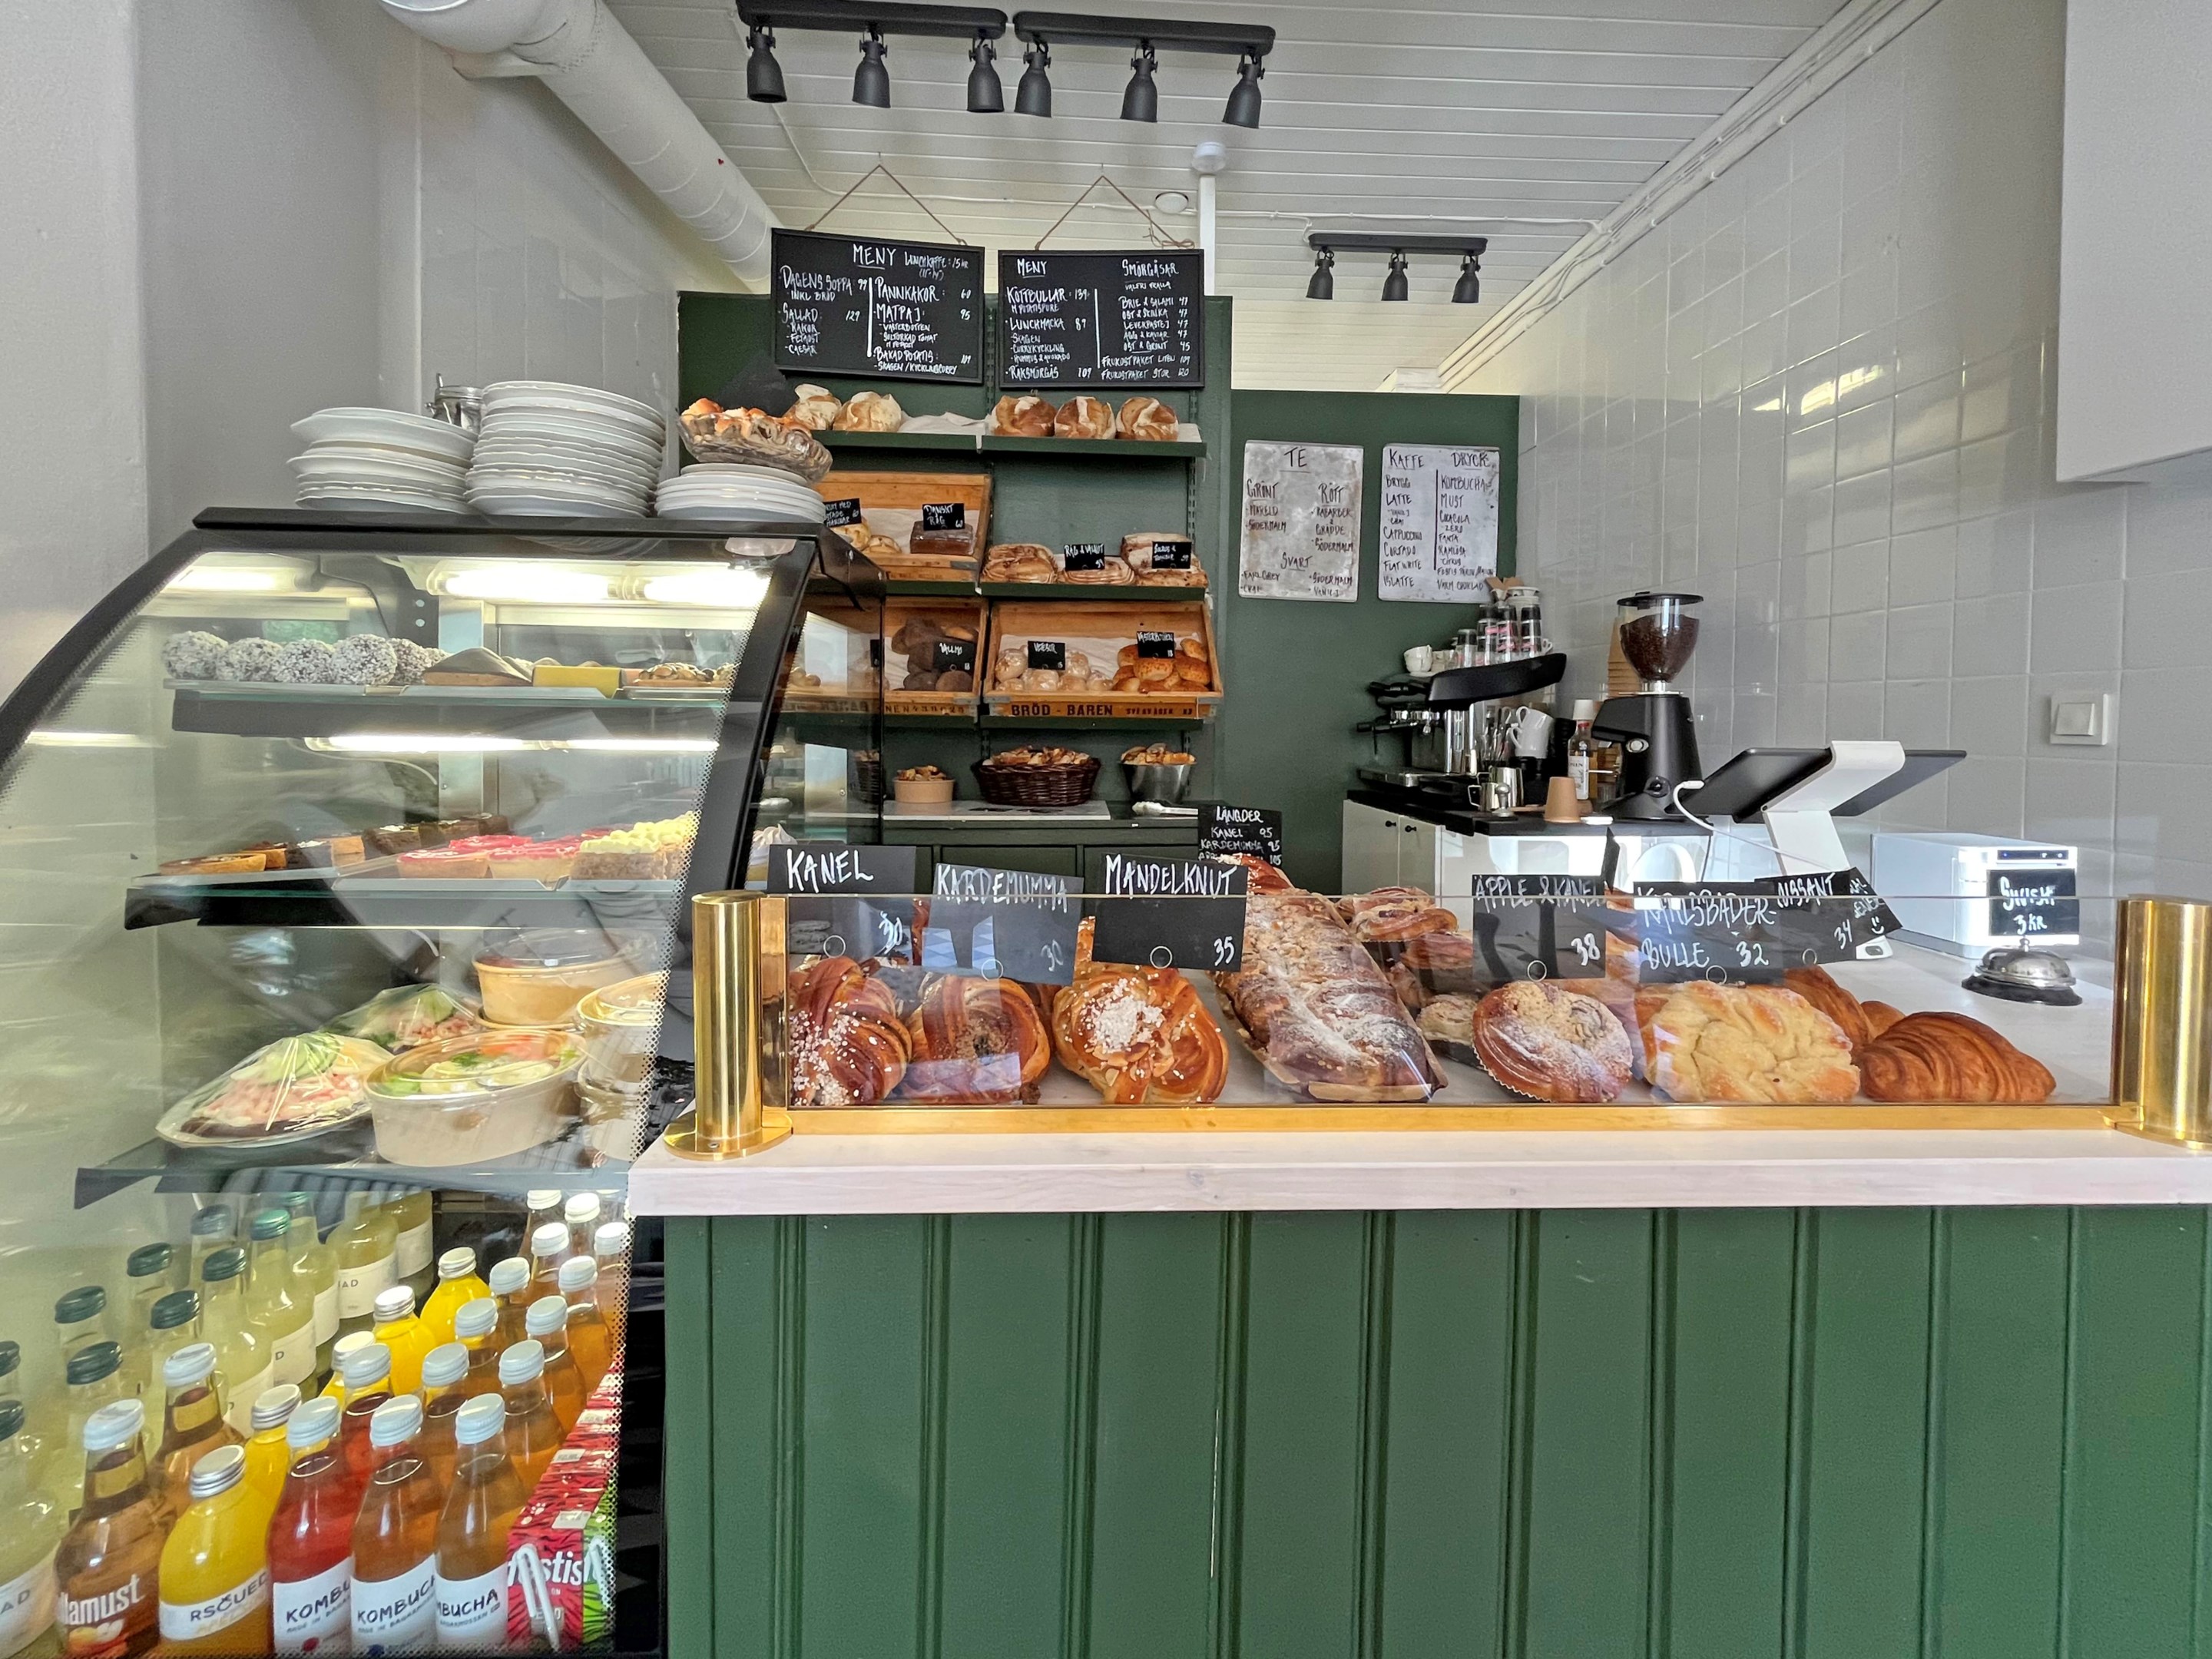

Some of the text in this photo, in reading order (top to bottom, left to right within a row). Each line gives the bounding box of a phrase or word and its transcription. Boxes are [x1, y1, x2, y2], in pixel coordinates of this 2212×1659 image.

[853, 243, 897, 267] MENY
[1016, 258, 1048, 276] MENY
[780, 265, 823, 292] DAGENS
[857, 278, 868, 290] 99
[790, 290, 812, 301] INKL
[1118, 296, 1142, 310] BRIE
[1149, 296, 1175, 310] SALAMI
[960, 308, 971, 321] 95
[1009, 316, 1088, 331] LUNCHMACKA 89
[1121, 310, 1136, 321] OST
[874, 346, 903, 363] BAKAD
[1283, 445, 1309, 469] TE
[1389, 449, 1426, 470] KAFFE
[1450, 452, 1490, 468] DRYCK
[1386, 494, 1412, 507] LATTE
[1440, 494, 1465, 508] MUST
[1280, 551, 1313, 571] SVART
[1011, 703, 1051, 716] BRÖD
[1067, 704, 1113, 716] BAREN
[1210, 826, 1243, 840] KANEL
[786, 849, 874, 893] KANEL
[1105, 853, 1237, 899] MANDELKNUT
[936, 864, 1068, 914] KARDEMUMMA
[1474, 875, 1534, 914] ÄPPLE
[1833, 919, 1853, 950] 34
[1041, 939, 1065, 972] 30
[1214, 935, 1235, 967] 35
[1571, 932, 1601, 967] 38
[1641, 938, 1770, 970] BULLE 32
